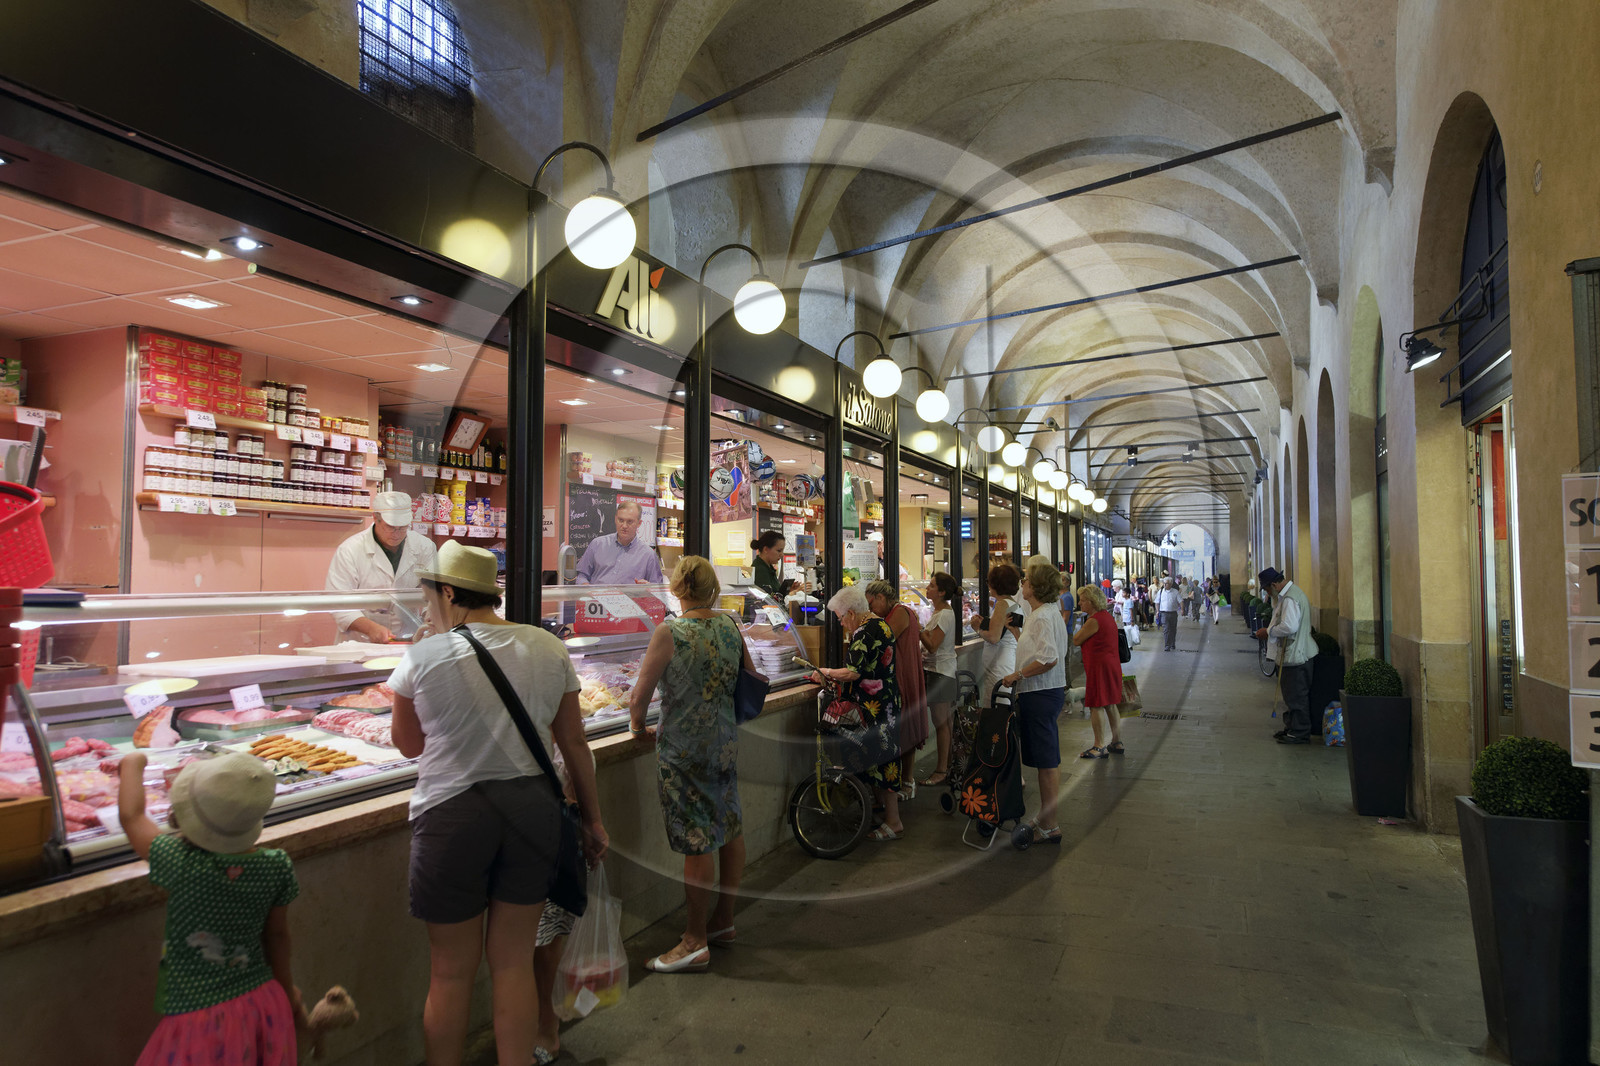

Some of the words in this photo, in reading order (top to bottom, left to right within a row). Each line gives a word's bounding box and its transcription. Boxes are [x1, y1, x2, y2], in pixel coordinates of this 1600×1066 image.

[844, 381, 856, 420] il
[855, 388, 892, 435] Salone
[588, 602, 604, 615] 01
